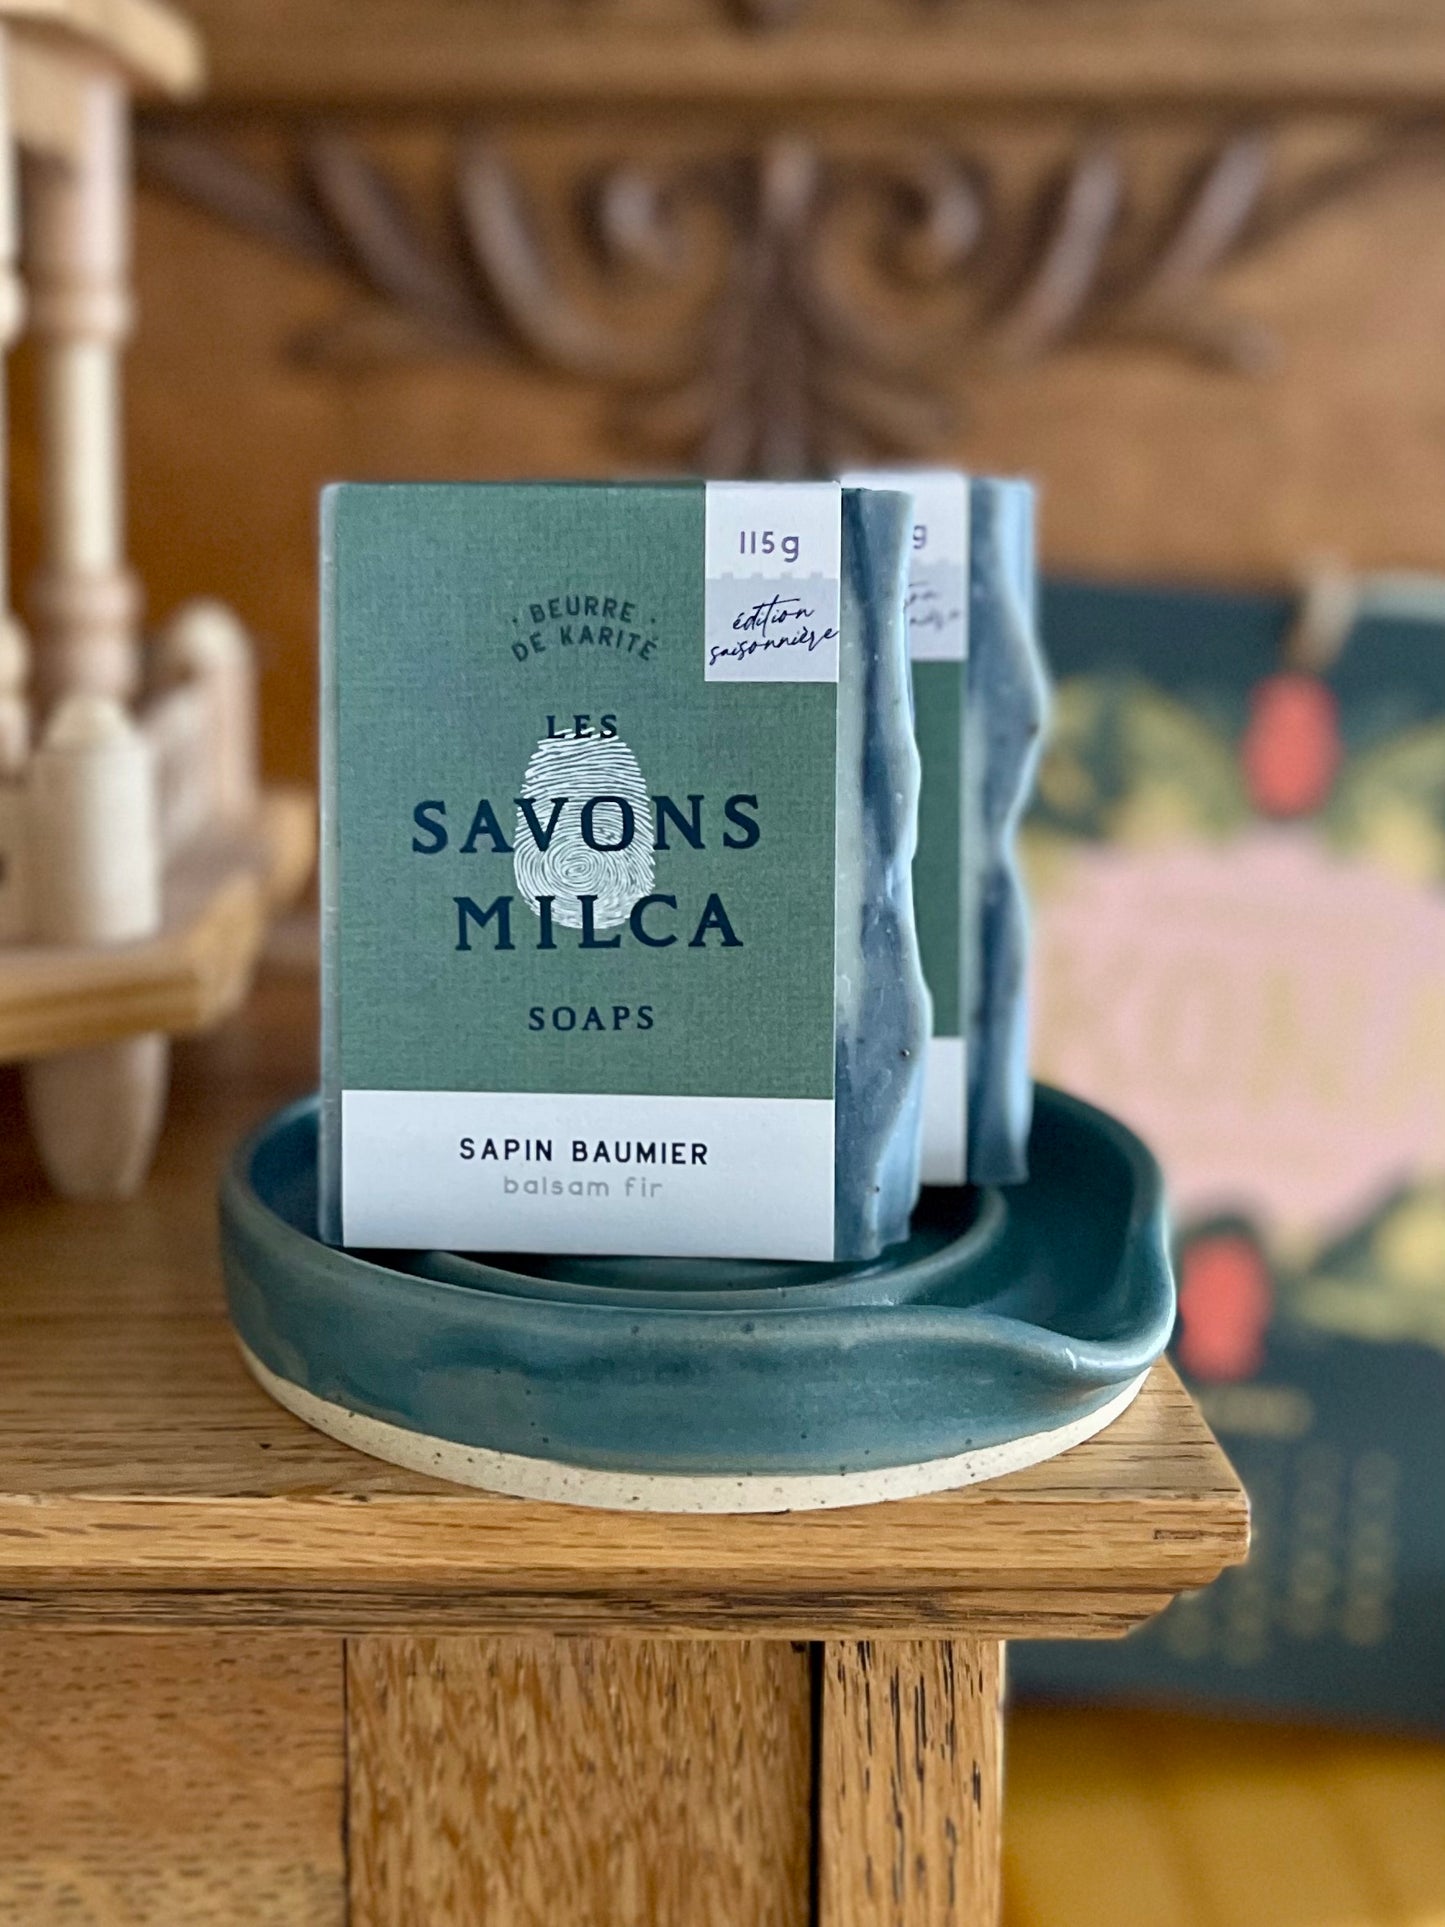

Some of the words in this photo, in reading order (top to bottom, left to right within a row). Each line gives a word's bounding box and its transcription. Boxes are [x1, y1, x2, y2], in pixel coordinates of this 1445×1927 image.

[739, 531, 800, 563] 115g
[529, 595, 636, 624] BEURRE
[732, 594, 815, 637] édition
[511, 632, 546, 663] DE
[560, 625, 659, 661] KARITÉ
[709, 626, 839, 665] saisonnière
[546, 714, 618, 739] LES
[412, 794, 761, 854] SAVONS
[453, 893, 744, 950] MILCA
[528, 1006, 654, 1031] SOAPS
[459, 1137, 552, 1161] SAPIN
[571, 1140, 708, 1165] BAUMIER
[503, 1175, 610, 1197] balsam
[625, 1176, 663, 1197] fir
